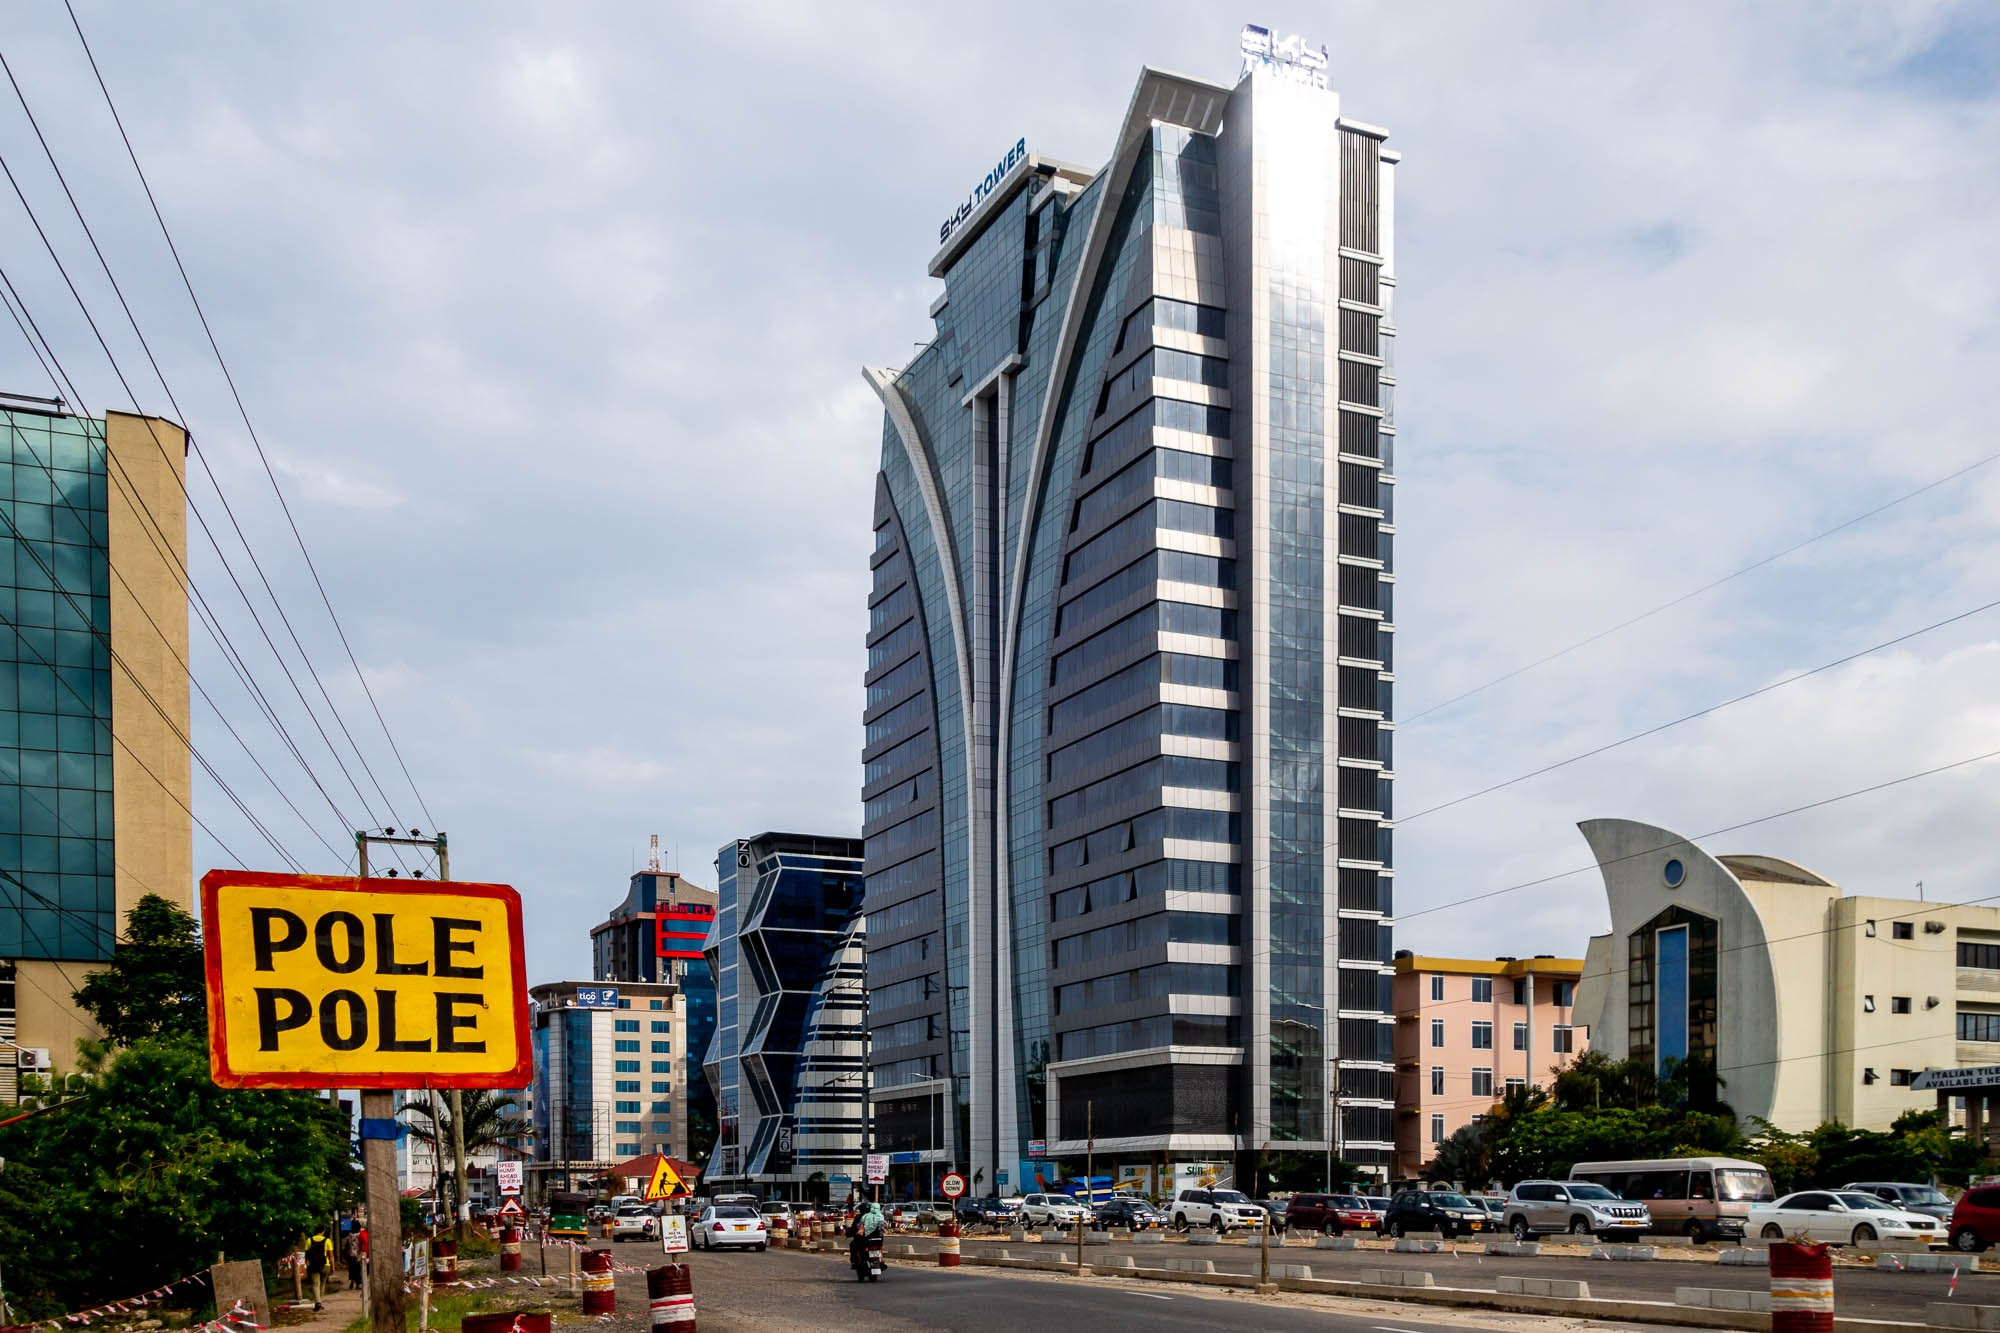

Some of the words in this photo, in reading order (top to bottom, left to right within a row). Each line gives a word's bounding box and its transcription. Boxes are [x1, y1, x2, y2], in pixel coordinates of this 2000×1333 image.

[940, 194, 972, 245] SKY
[974, 137, 1025, 205] TOWER
[249, 907, 484, 979] POLE
[253, 987, 487, 1053] POLE
[1925, 1077, 1983, 1088] AVAILABLE
[1932, 1069, 1973, 1079] ITALIAN
